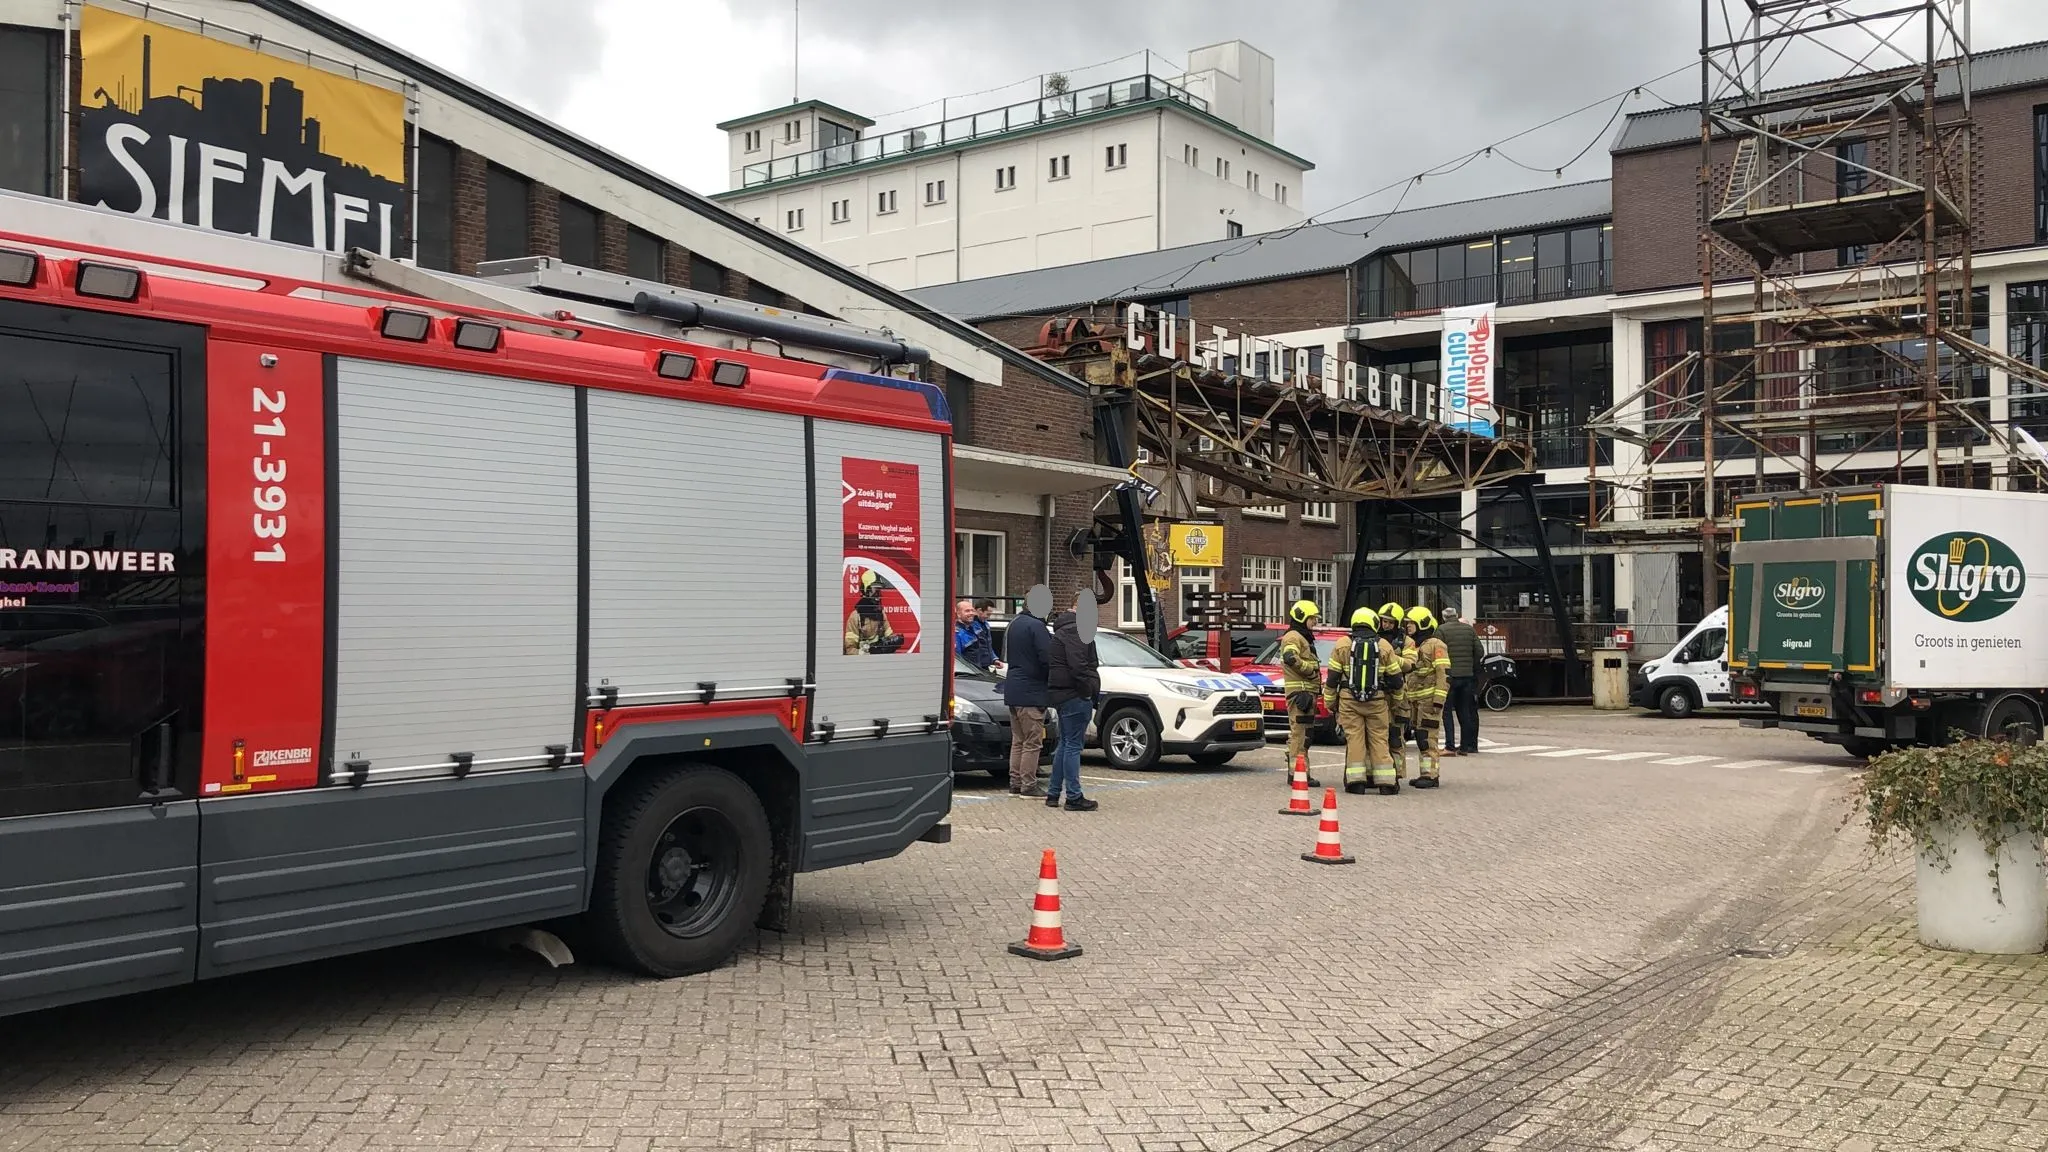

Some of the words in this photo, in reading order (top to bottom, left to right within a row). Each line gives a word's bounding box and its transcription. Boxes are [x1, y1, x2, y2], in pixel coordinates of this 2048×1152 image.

[1467, 316, 1490, 406] PHOENIX
[252, 387, 287, 563] 21-3931
[857, 488, 875, 497] Zoek
[857, 500, 893, 511] uitdaging?
[880, 524, 898, 533] Veghel
[1914, 553, 2021, 601] Sligro
[1777, 583, 1822, 600] Sligro
[1782, 639, 1812, 650] sligro.nl
[1915, 633, 1953, 648] Groots
[1957, 634, 1968, 648] in
[1971, 635, 2022, 651] genieten
[269, 748, 312, 760] KENBRI
[351, 751, 361, 760] K1
